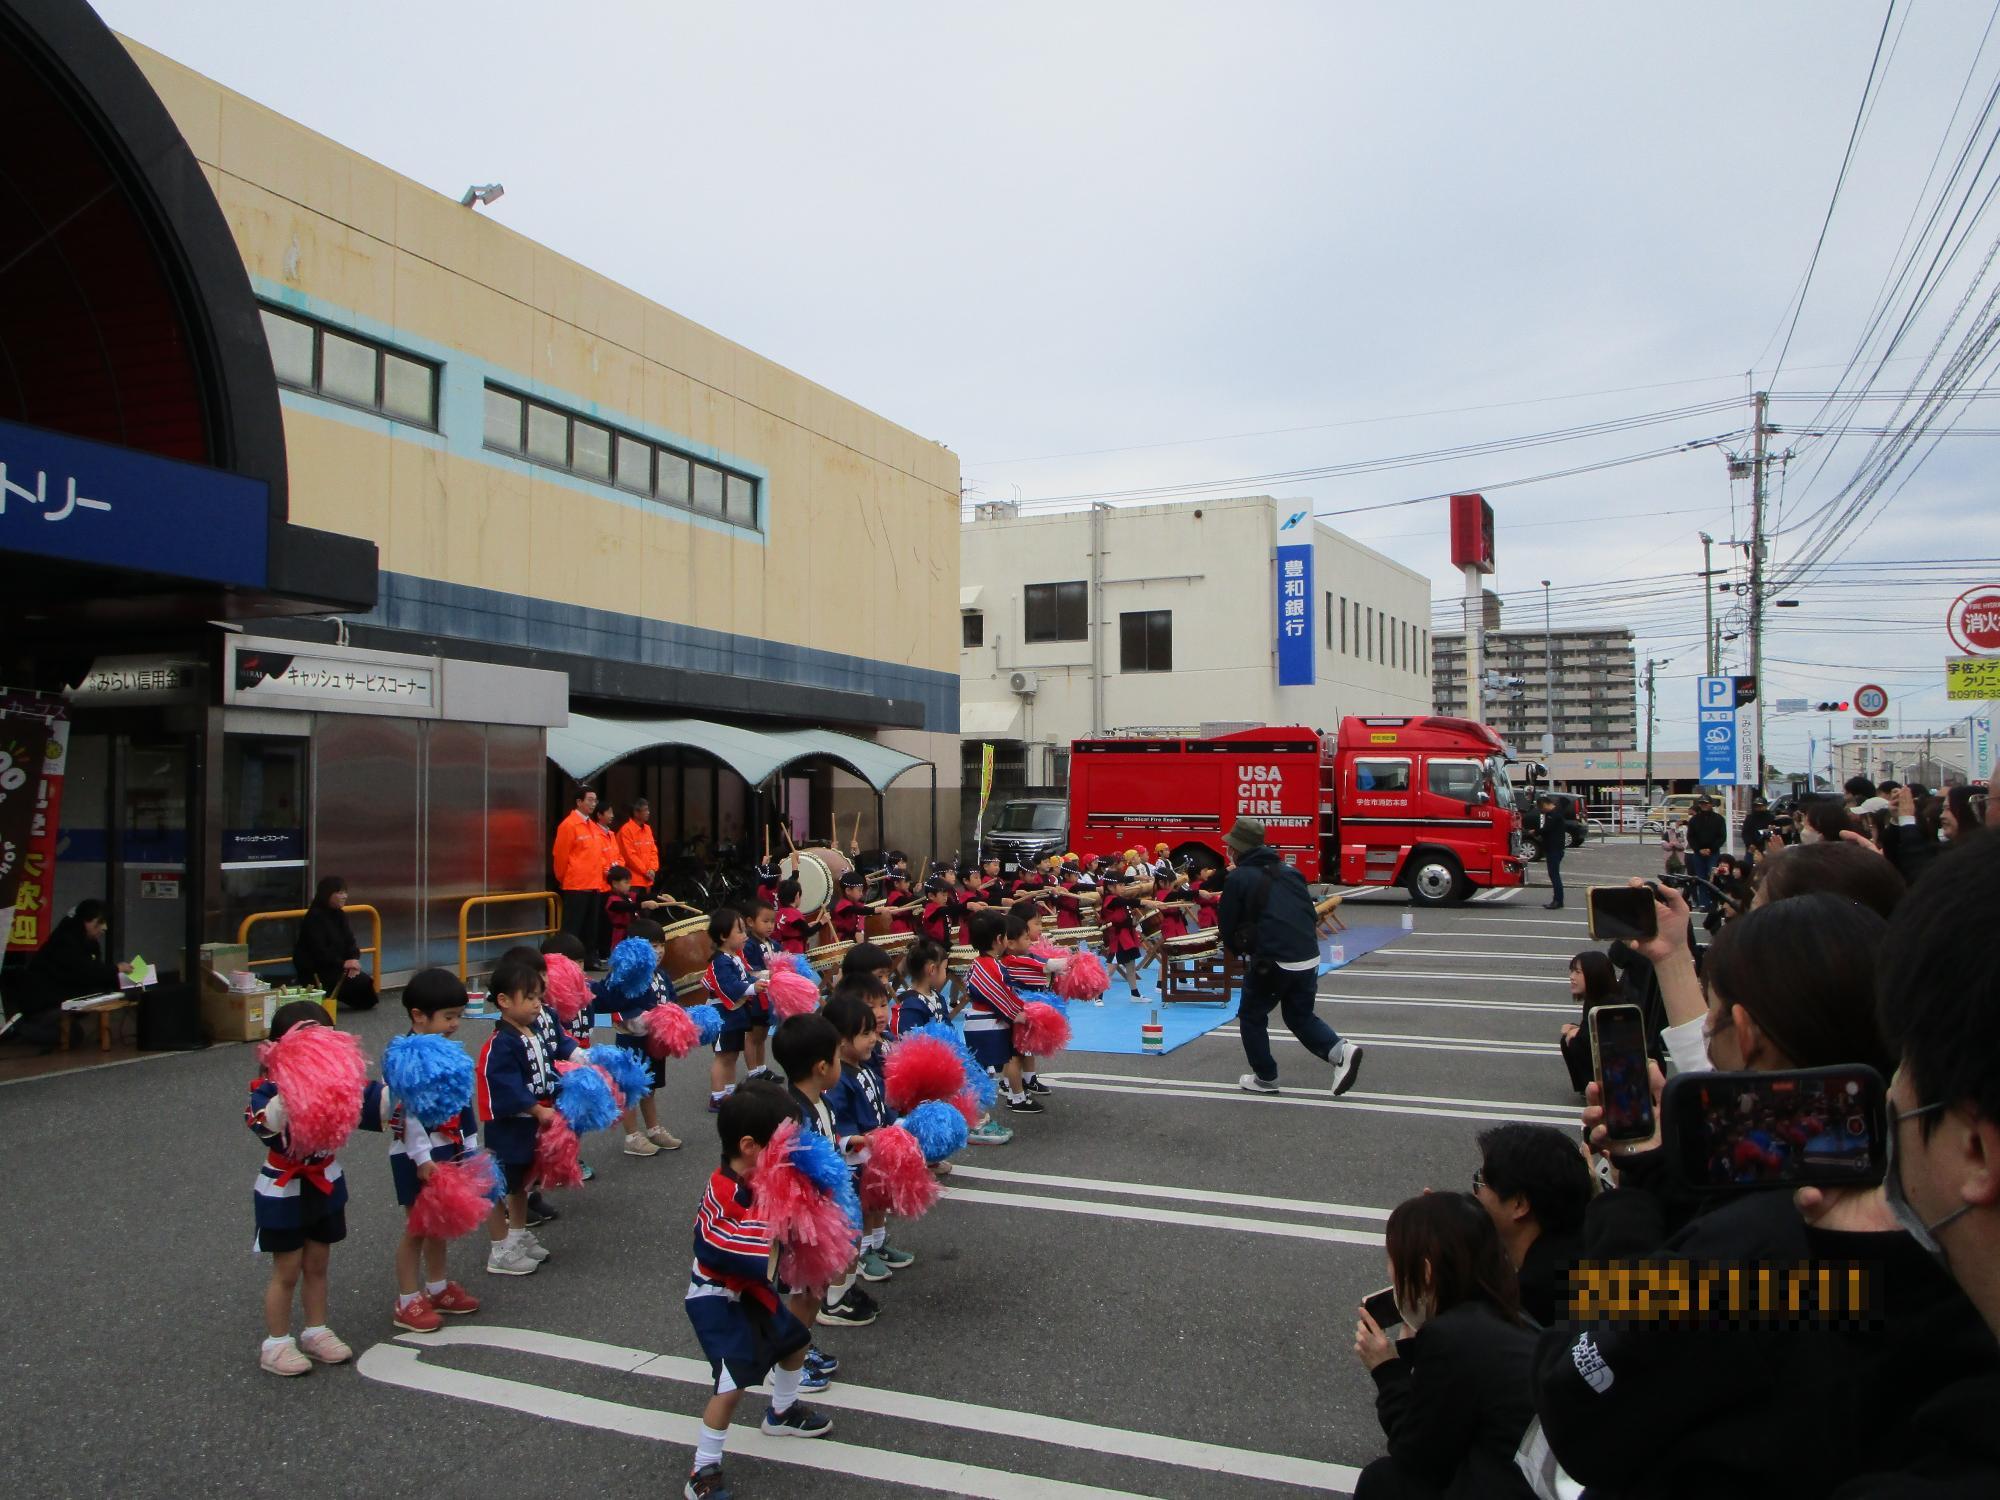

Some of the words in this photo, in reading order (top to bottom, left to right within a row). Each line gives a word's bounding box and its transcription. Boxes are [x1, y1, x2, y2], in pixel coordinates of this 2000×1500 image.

[0, 461, 112, 521] トリー
[1284, 560, 1304, 637] 豊和銀行
[1965, 611, 2000, 634] 消火
[1948, 661, 2000, 675] 宇佐メデ
[288, 666, 341, 689] キャッシュ
[345, 672, 427, 695] サービスコーナー
[1709, 681, 1726, 704] P
[1861, 693, 1881, 708] 30
[1706, 712, 1728, 721] 入口
[1238, 765, 1283, 782] USA
[1238, 783, 1283, 798] CITY
[1238, 799, 1282, 814] FIRE
[1356, 798, 1408, 807] 宇佐市消防本部
[1571, 1345, 1589, 1377] FACE
[1579, 1331, 1599, 1372] NORTH
[1588, 1341, 1606, 1367] THE
